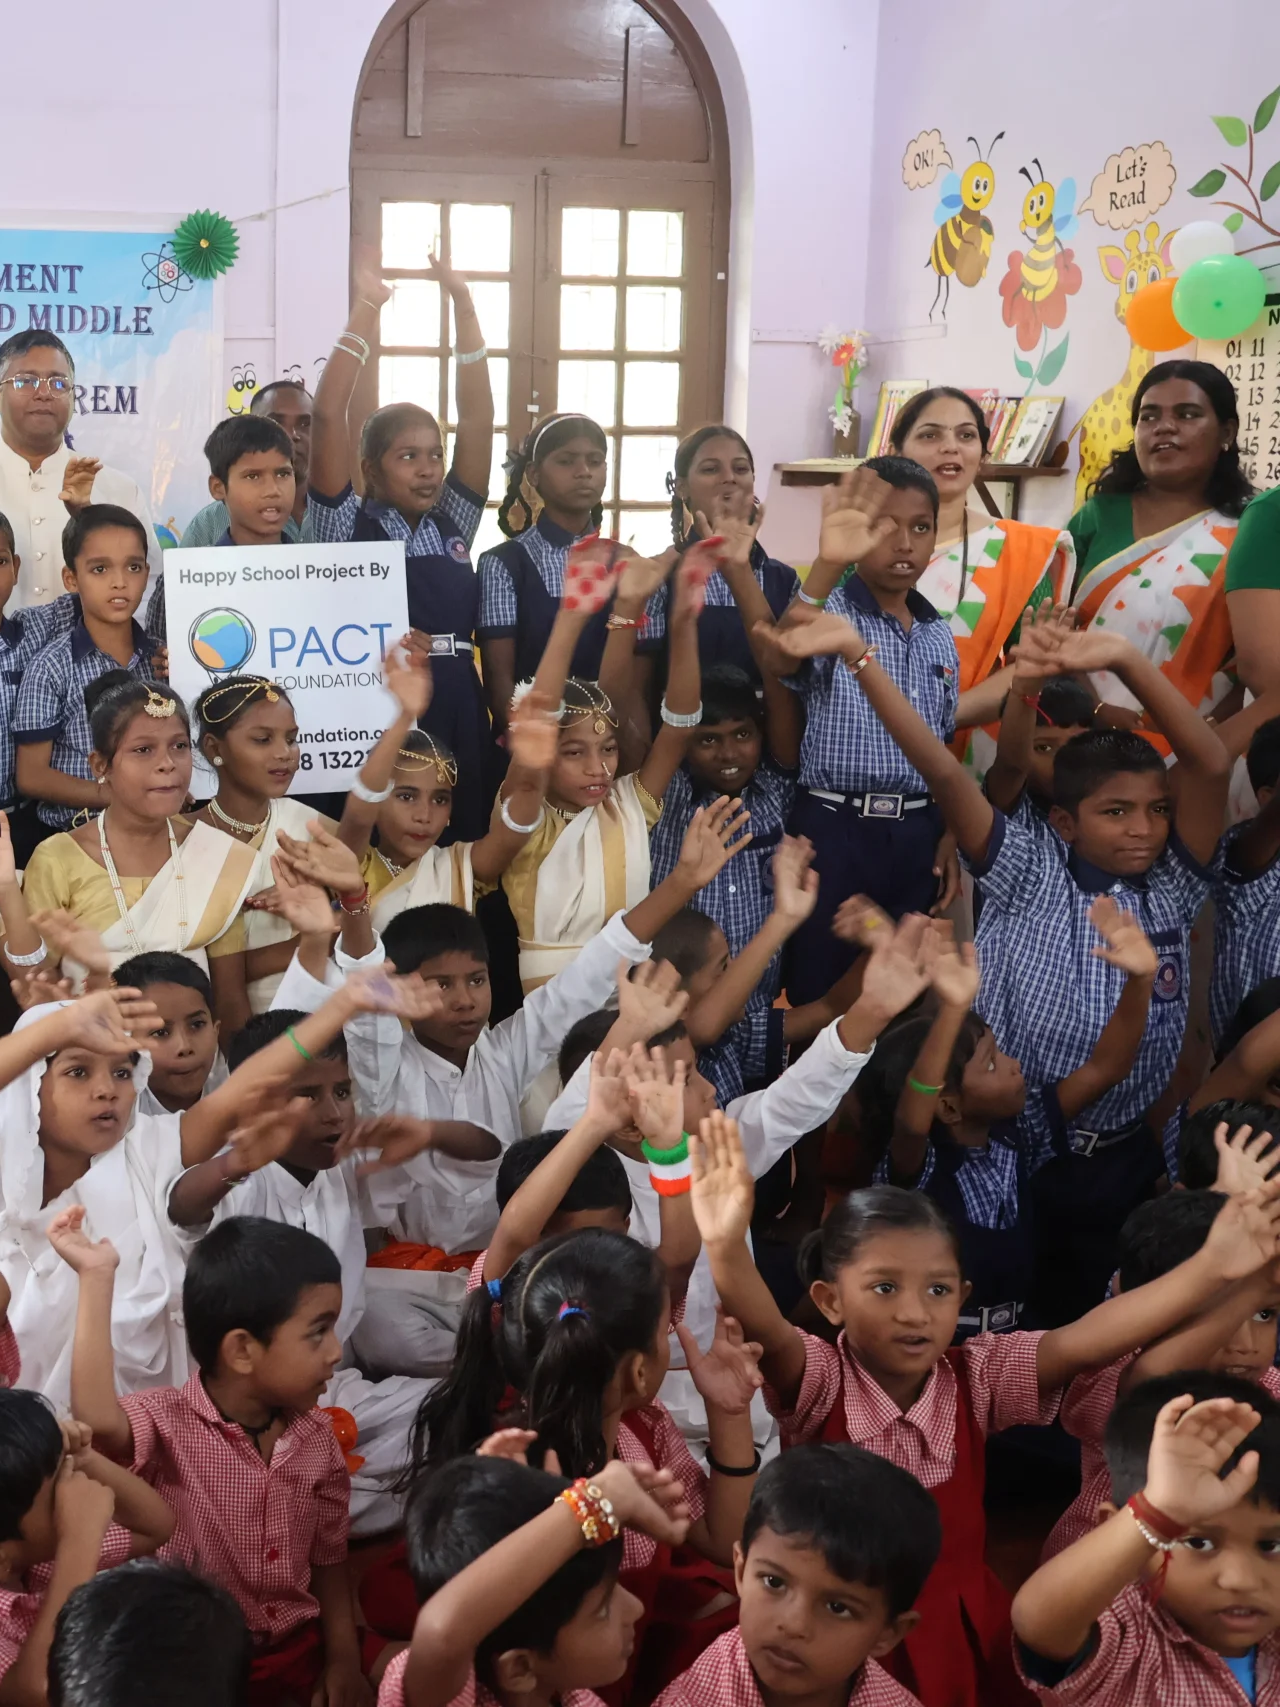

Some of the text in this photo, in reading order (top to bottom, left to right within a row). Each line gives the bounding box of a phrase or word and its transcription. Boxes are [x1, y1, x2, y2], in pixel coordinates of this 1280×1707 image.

[914, 149, 933, 171] OK!
[1116, 156, 1148, 183] Let's
[1109, 180, 1146, 212] Read
[28, 303, 155, 336] MIDDLE
[1225, 339, 1242, 359] 01
[1250, 337, 1265, 358] 11
[1248, 361, 1265, 382] 12
[1246, 386, 1265, 407] 13
[1244, 411, 1261, 432] 14
[178, 562, 390, 588] Happy School Project By
[268, 622, 393, 669] PACT
[274, 671, 383, 691] FOUNDATION
[318, 749, 372, 770] 1322
